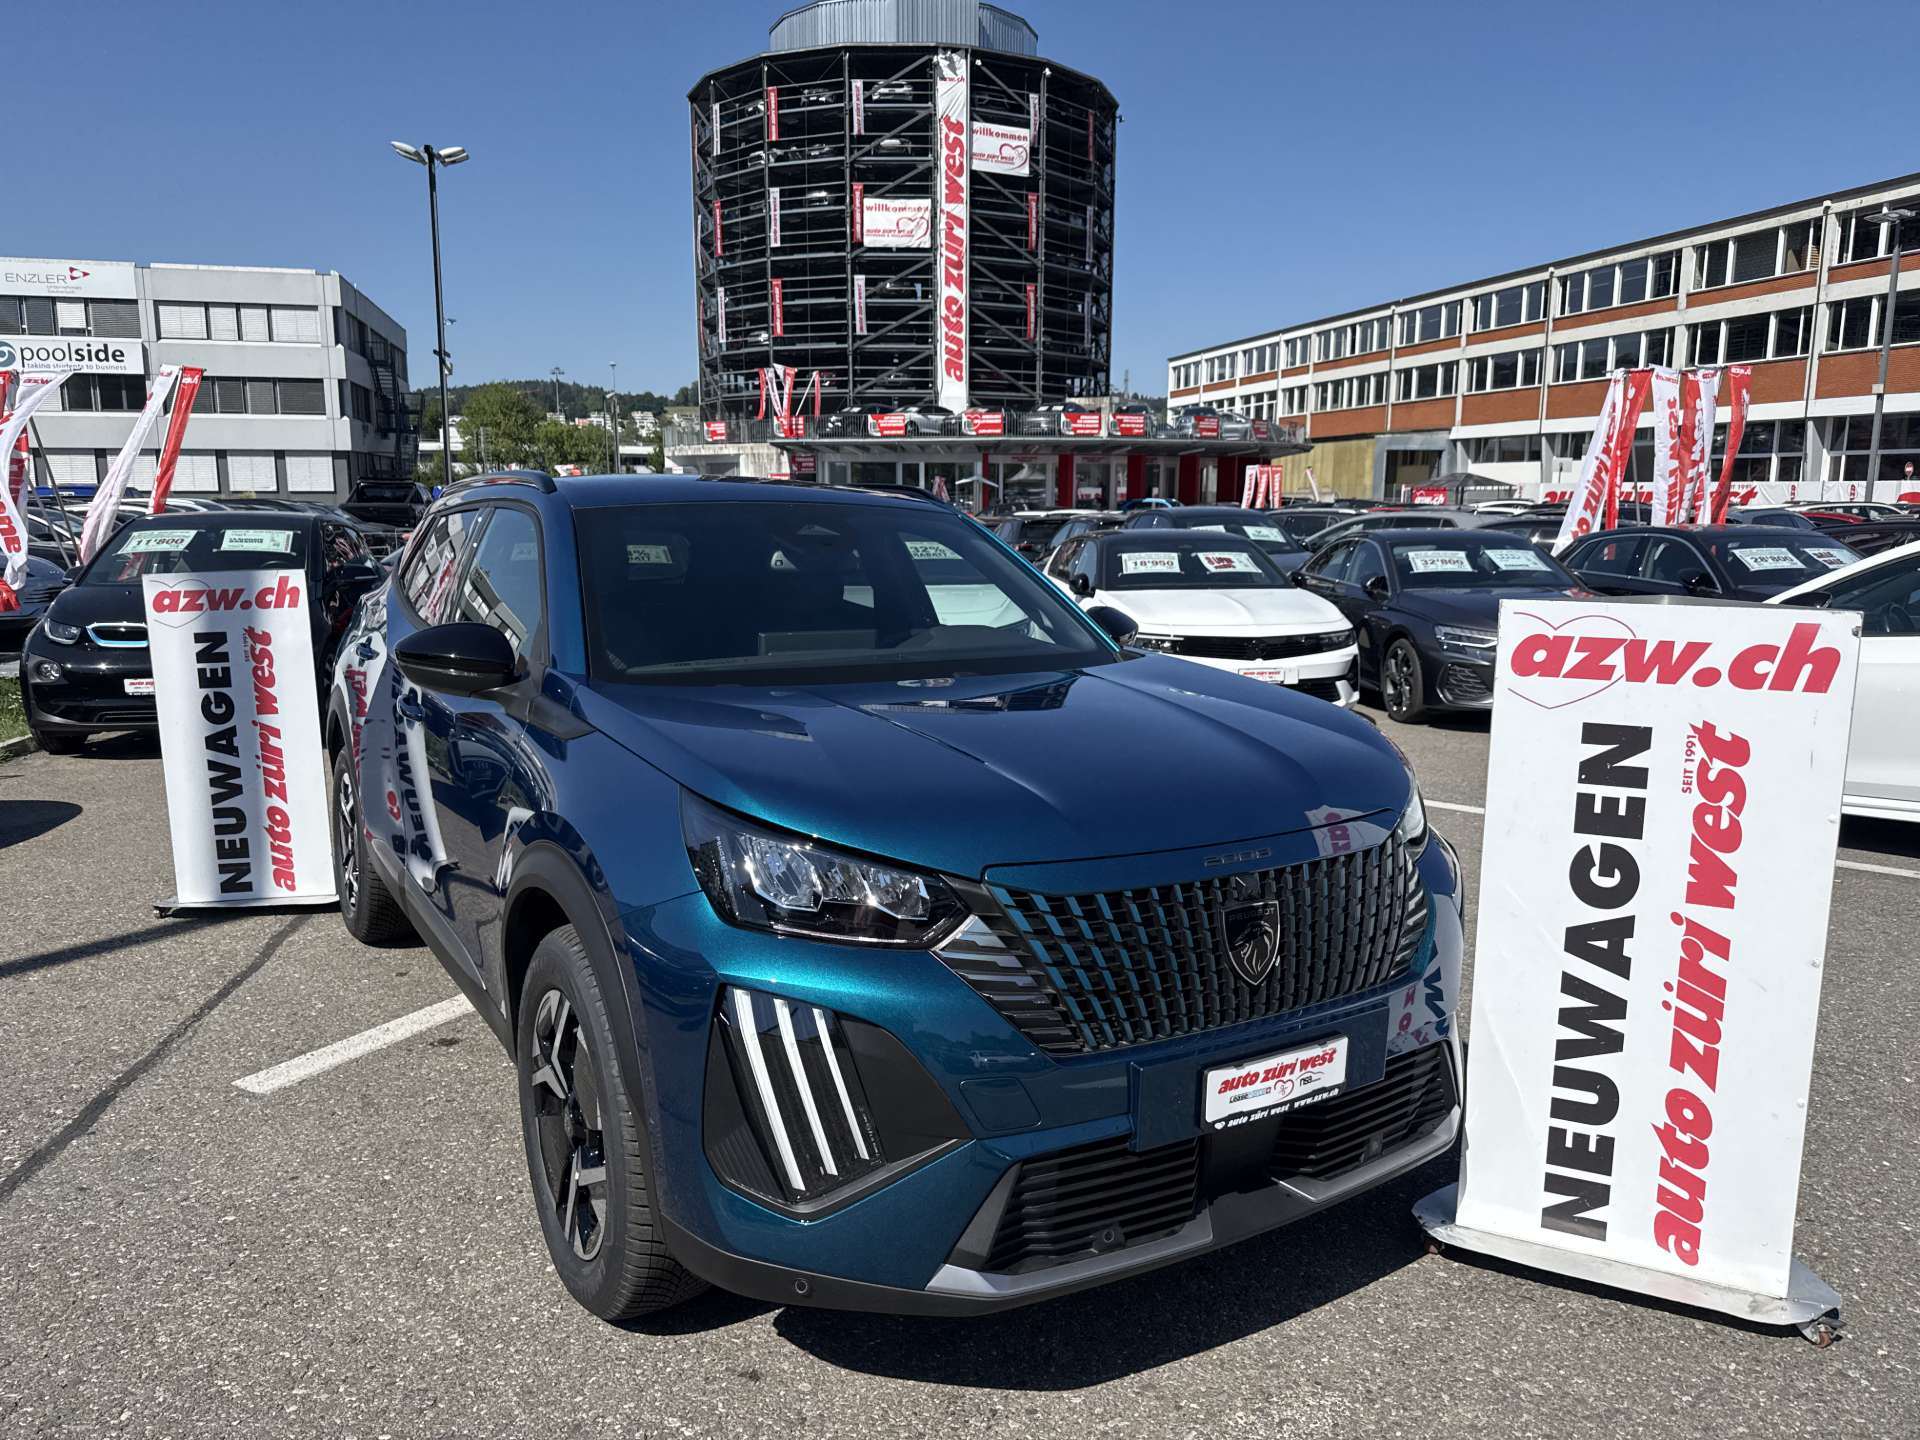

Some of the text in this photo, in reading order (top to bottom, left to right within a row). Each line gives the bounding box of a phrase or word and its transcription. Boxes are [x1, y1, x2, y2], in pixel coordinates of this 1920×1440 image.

[972, 127, 1028, 141] willkommen
[939, 114, 965, 382] auto züri west
[5, 272, 68, 284] ENZLER
[20, 342, 125, 368] poolside
[95, 363, 127, 371] business
[136, 538, 185, 546] 11'800
[1420, 558, 1464, 566] 32'800
[152, 575, 301, 613] azw.ch
[1509, 623, 1841, 694] azw.ch
[193, 631, 253, 894] NEUWAGEN
[243, 625, 296, 892] auto züri west
[1681, 734, 1697, 794] SEIT 1991
[1541, 722, 1653, 1242] NEUWAGEN
[1650, 719, 1751, 1267] auto züri west
[1217, 1047, 1337, 1094] auto züri west
[1227, 1088, 1340, 1127] auto züri west www.azw.ch
